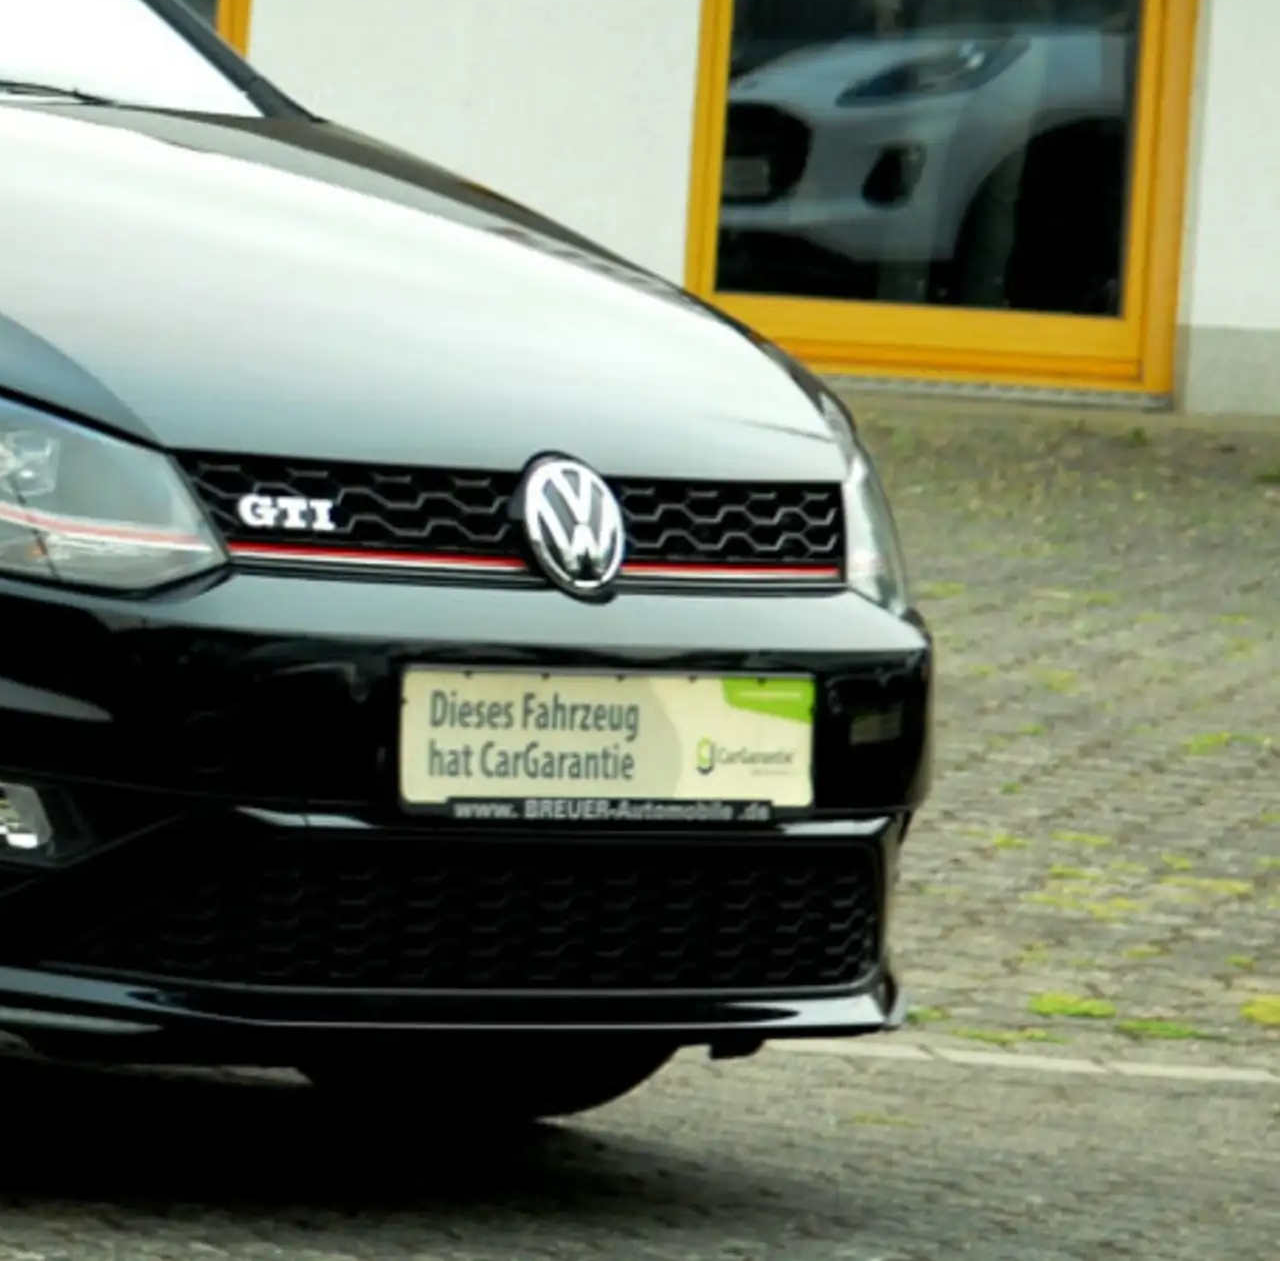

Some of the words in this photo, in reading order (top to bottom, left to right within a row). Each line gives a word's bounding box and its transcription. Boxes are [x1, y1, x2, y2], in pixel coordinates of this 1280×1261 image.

[239, 495, 336, 532] GTI
[430, 690, 514, 729] Dieses
[521, 692, 640, 742] Fahrzeug
[428, 740, 473, 780] hat
[479, 742, 635, 781] CarGarantie
